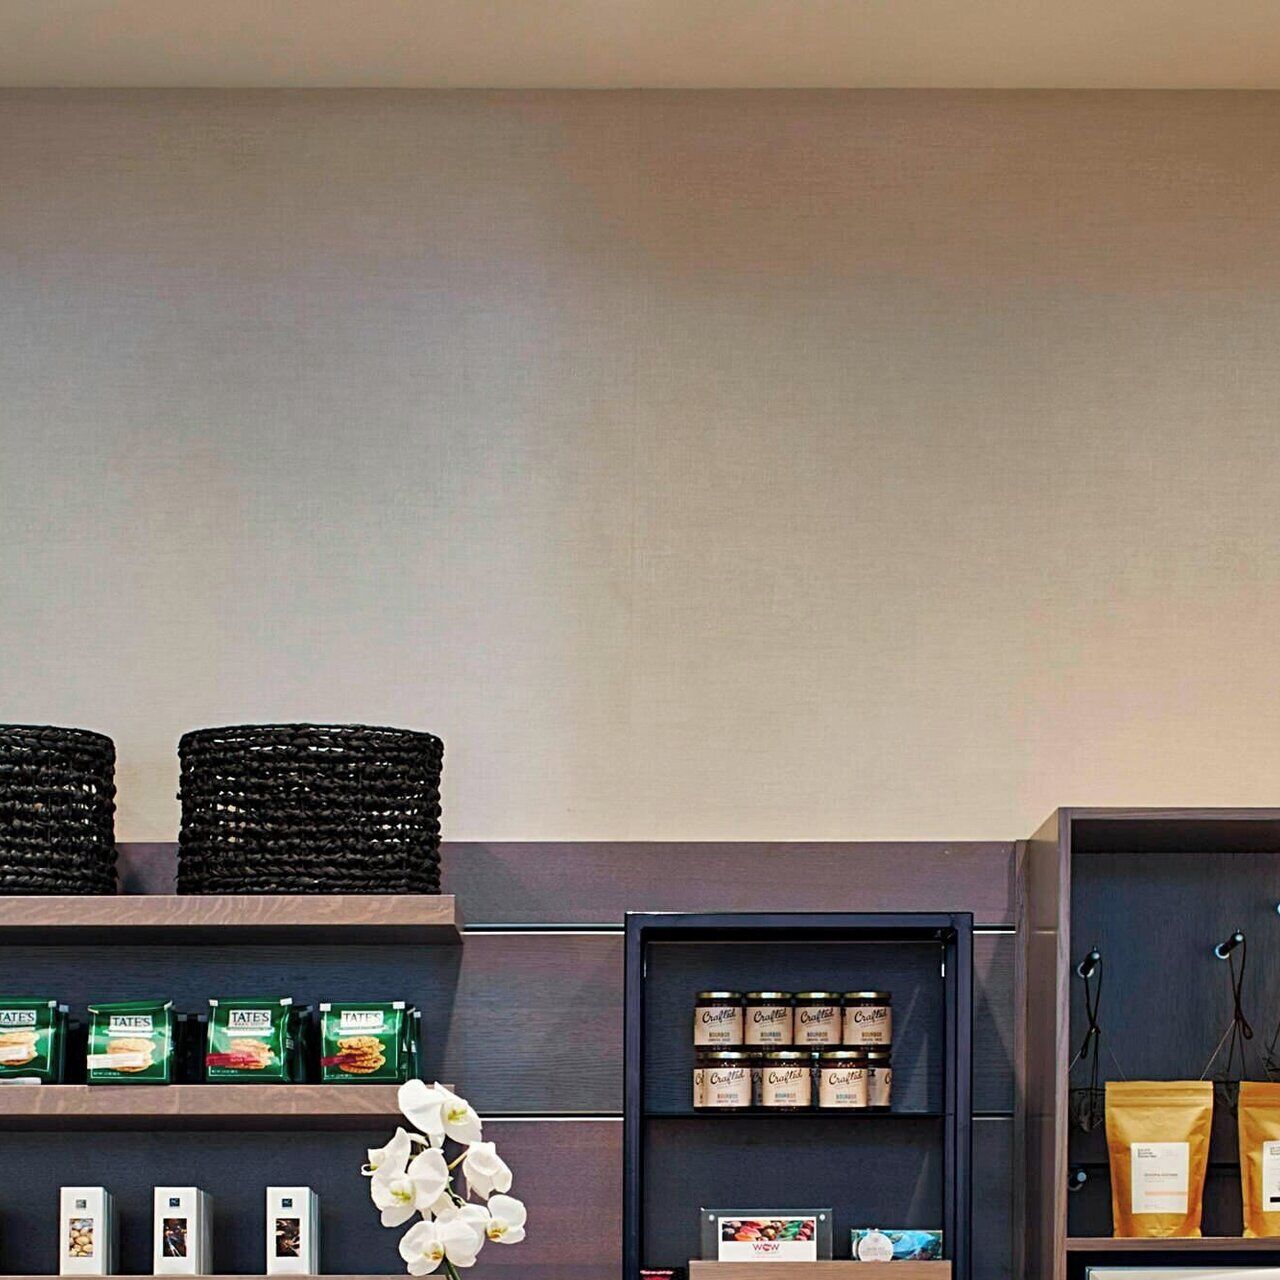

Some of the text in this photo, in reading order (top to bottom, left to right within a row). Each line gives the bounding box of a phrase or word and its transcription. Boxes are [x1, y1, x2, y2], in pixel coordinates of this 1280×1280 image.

[113, 1017, 150, 1027] TATE'S
[232, 1012, 269, 1022] TATE'S
[343, 1013, 381, 1023] TATE'S
[702, 1009, 736, 1023] Crafted
[754, 1009, 788, 1023] Crafted
[800, 1009, 834, 1023] Crafted
[854, 1009, 887, 1023] Crafted
[710, 1070, 745, 1085] Crafted
[769, 1070, 803, 1085] Crafted
[829, 1070, 863, 1085] Crafted
